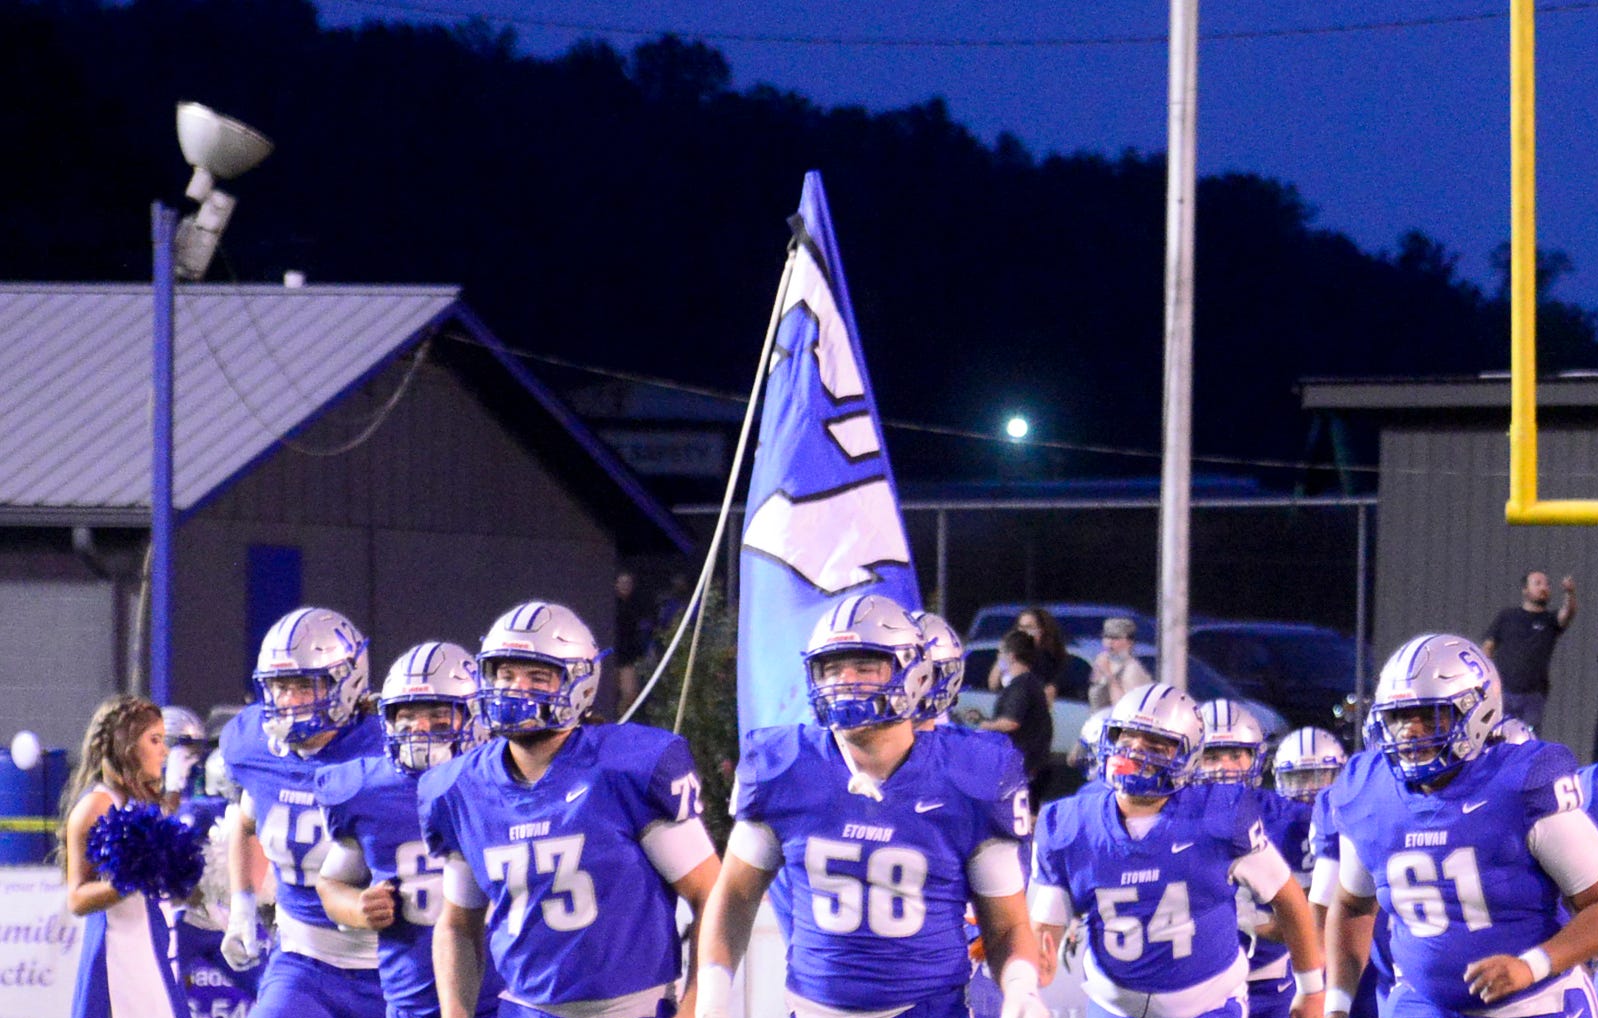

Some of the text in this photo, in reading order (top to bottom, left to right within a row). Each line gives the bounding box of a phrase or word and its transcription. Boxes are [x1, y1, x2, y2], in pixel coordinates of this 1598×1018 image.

[509, 820, 550, 841] ETOWAH
[842, 823, 894, 843] ETOWAH
[1404, 830, 1448, 849] ETOWAH
[483, 833, 599, 937] 73
[805, 836, 928, 939] 58
[1120, 868, 1161, 886] ETOWAH
[1386, 845, 1494, 938] 61
[0, 914, 77, 956] mily
[1094, 880, 1197, 962] 54
